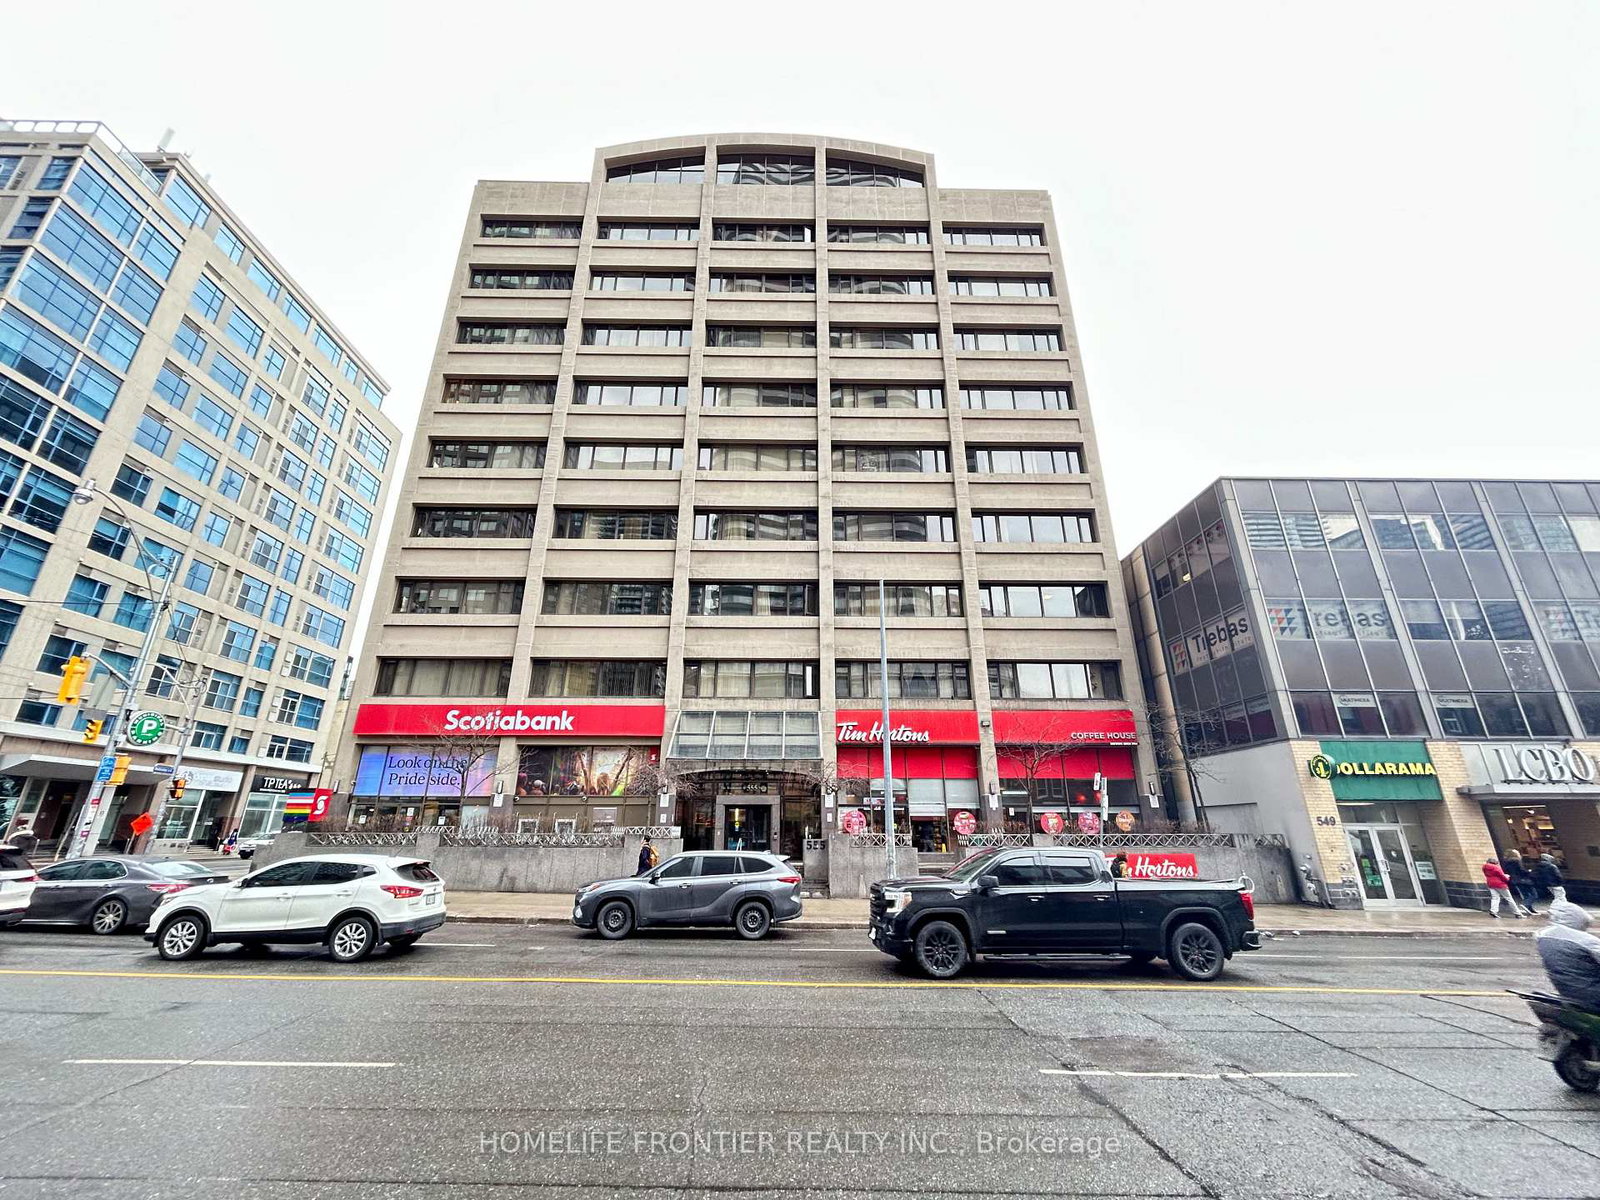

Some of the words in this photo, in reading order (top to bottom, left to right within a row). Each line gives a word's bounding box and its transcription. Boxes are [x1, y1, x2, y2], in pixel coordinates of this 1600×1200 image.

[141, 719, 158, 734] P
[444, 710, 575, 731] Scotiabank
[837, 722, 867, 741] Tim
[868, 721, 930, 742] Hrtons
[388, 756, 421, 769] Look
[1492, 747, 1595, 781] LCBO
[263, 777, 276, 788] TP
[275, 778, 288, 789] TEA
[388, 772, 425, 785] Pride
[429, 773, 461, 785] side.
[1316, 816, 1336, 826] 549
[806, 841, 826, 850] 555
[1135, 855, 1195, 877] Hortons
